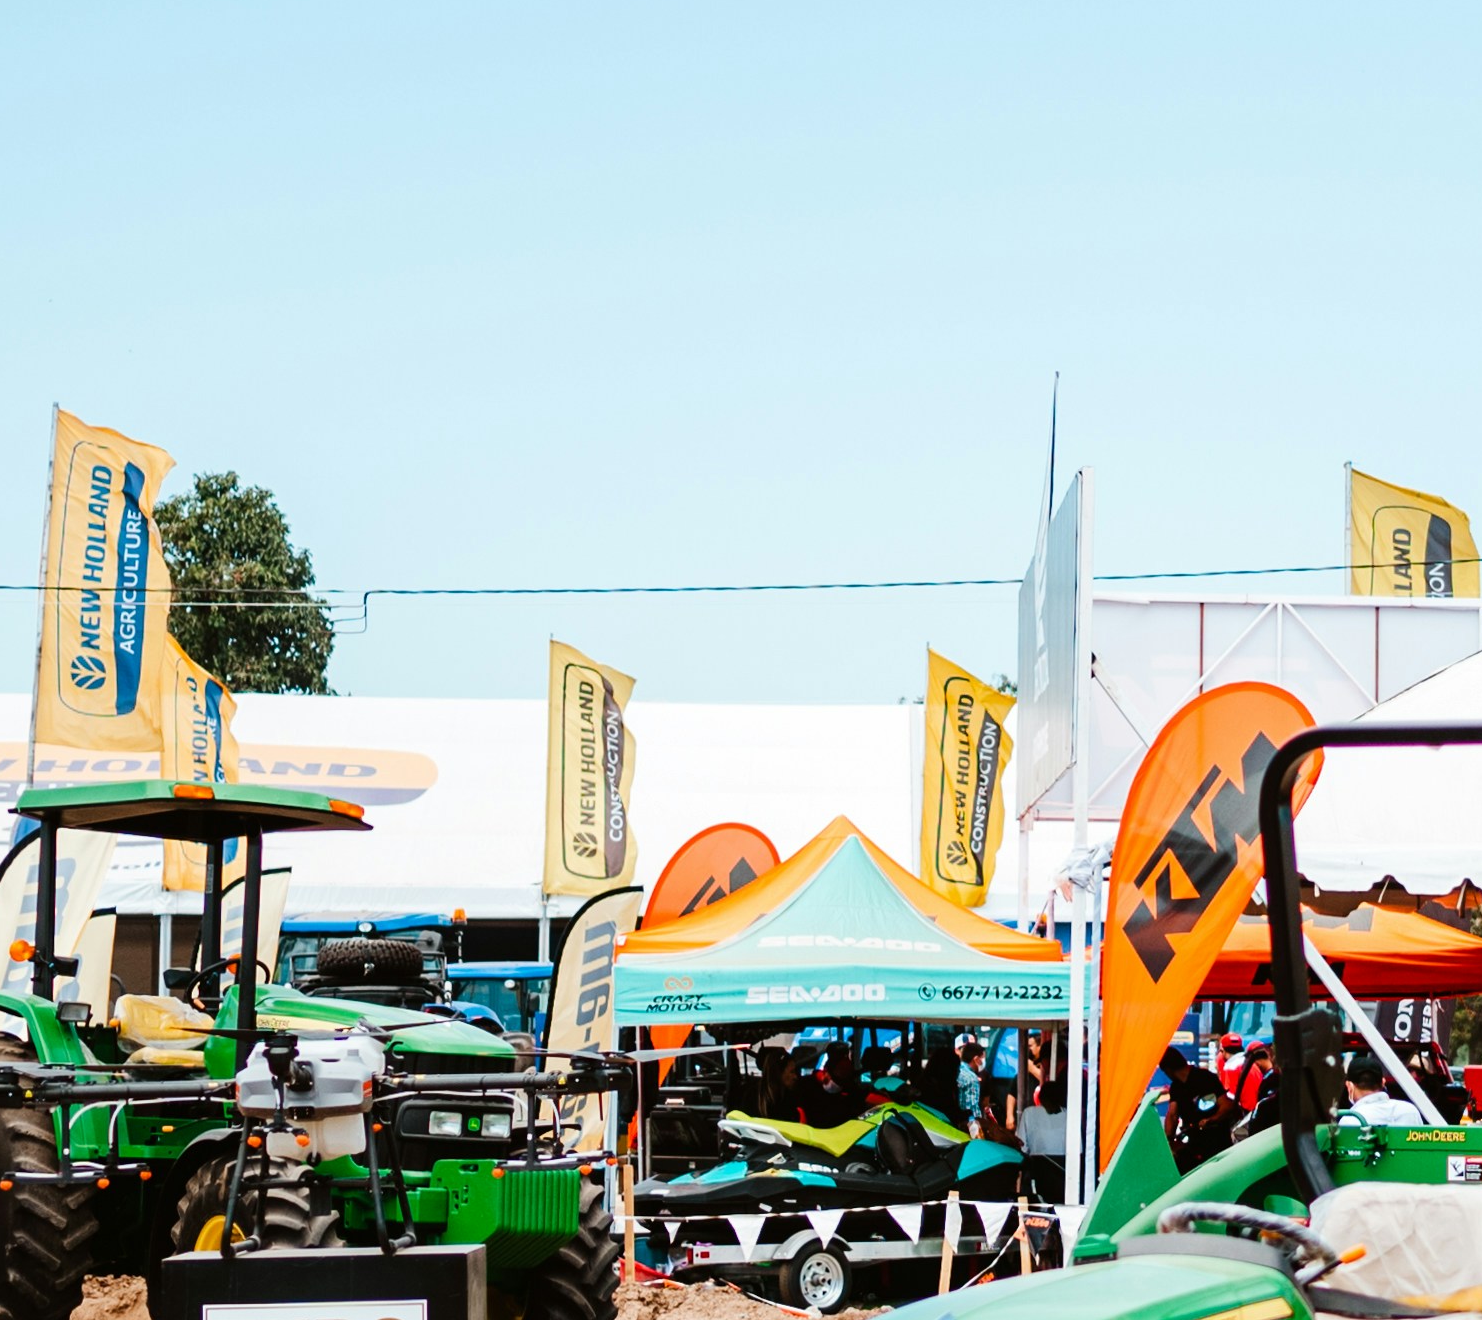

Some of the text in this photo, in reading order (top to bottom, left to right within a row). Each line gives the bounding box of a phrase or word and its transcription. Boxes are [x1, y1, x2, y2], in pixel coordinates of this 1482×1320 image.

[79, 464, 113, 651] NEW HOLLAND
[119, 510, 143, 655] AGRICULTURE
[1393, 528, 1413, 597] LAND
[578, 681, 596, 826] NEW HOLLAND
[956, 693, 975, 785] HOLLAND
[970, 721, 998, 854] CONSTRUCTION
[645, 1002, 712, 1013] MOTORS
[652, 993, 704, 1003] CRAZY
[1406, 1129, 1466, 1142] JOHN DEERE
